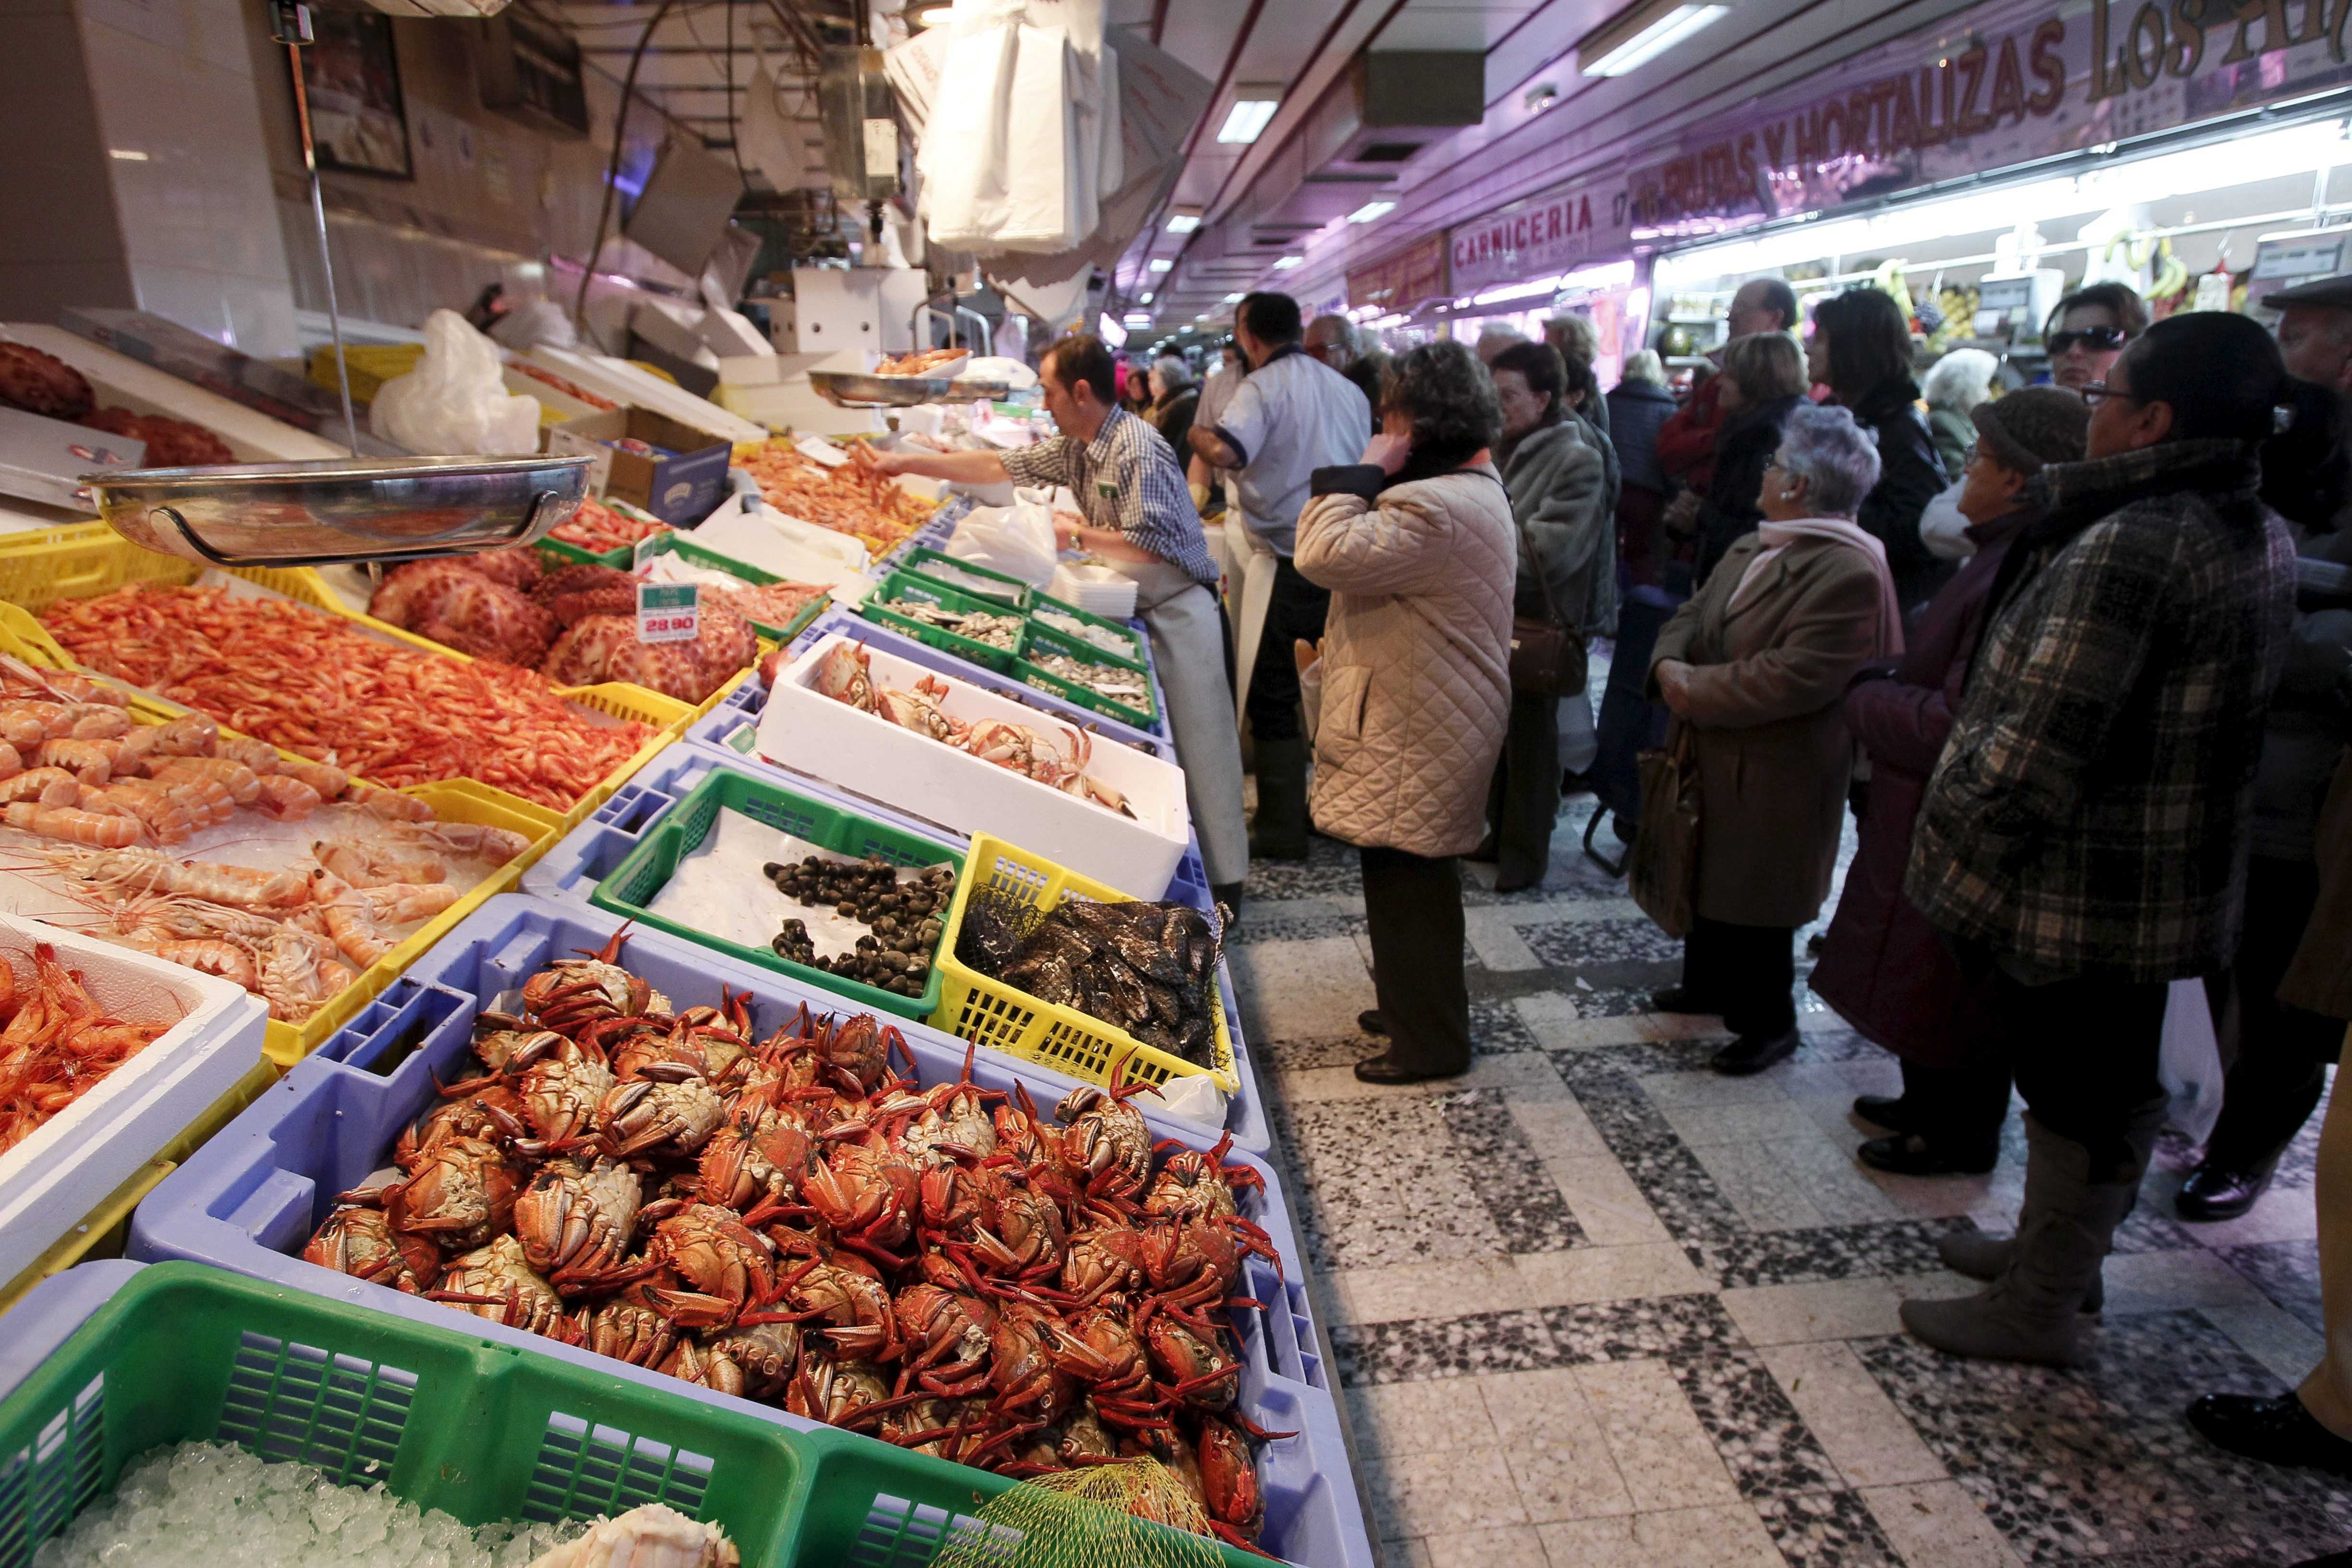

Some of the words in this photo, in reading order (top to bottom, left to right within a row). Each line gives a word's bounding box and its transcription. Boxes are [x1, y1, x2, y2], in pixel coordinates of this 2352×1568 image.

[1662, 129, 1758, 215] FRUTAS
[1763, 122, 1786, 190] Y
[1795, 18, 2064, 179] HORTALIZAS
[1454, 194, 1592, 269] CARNICERIA
